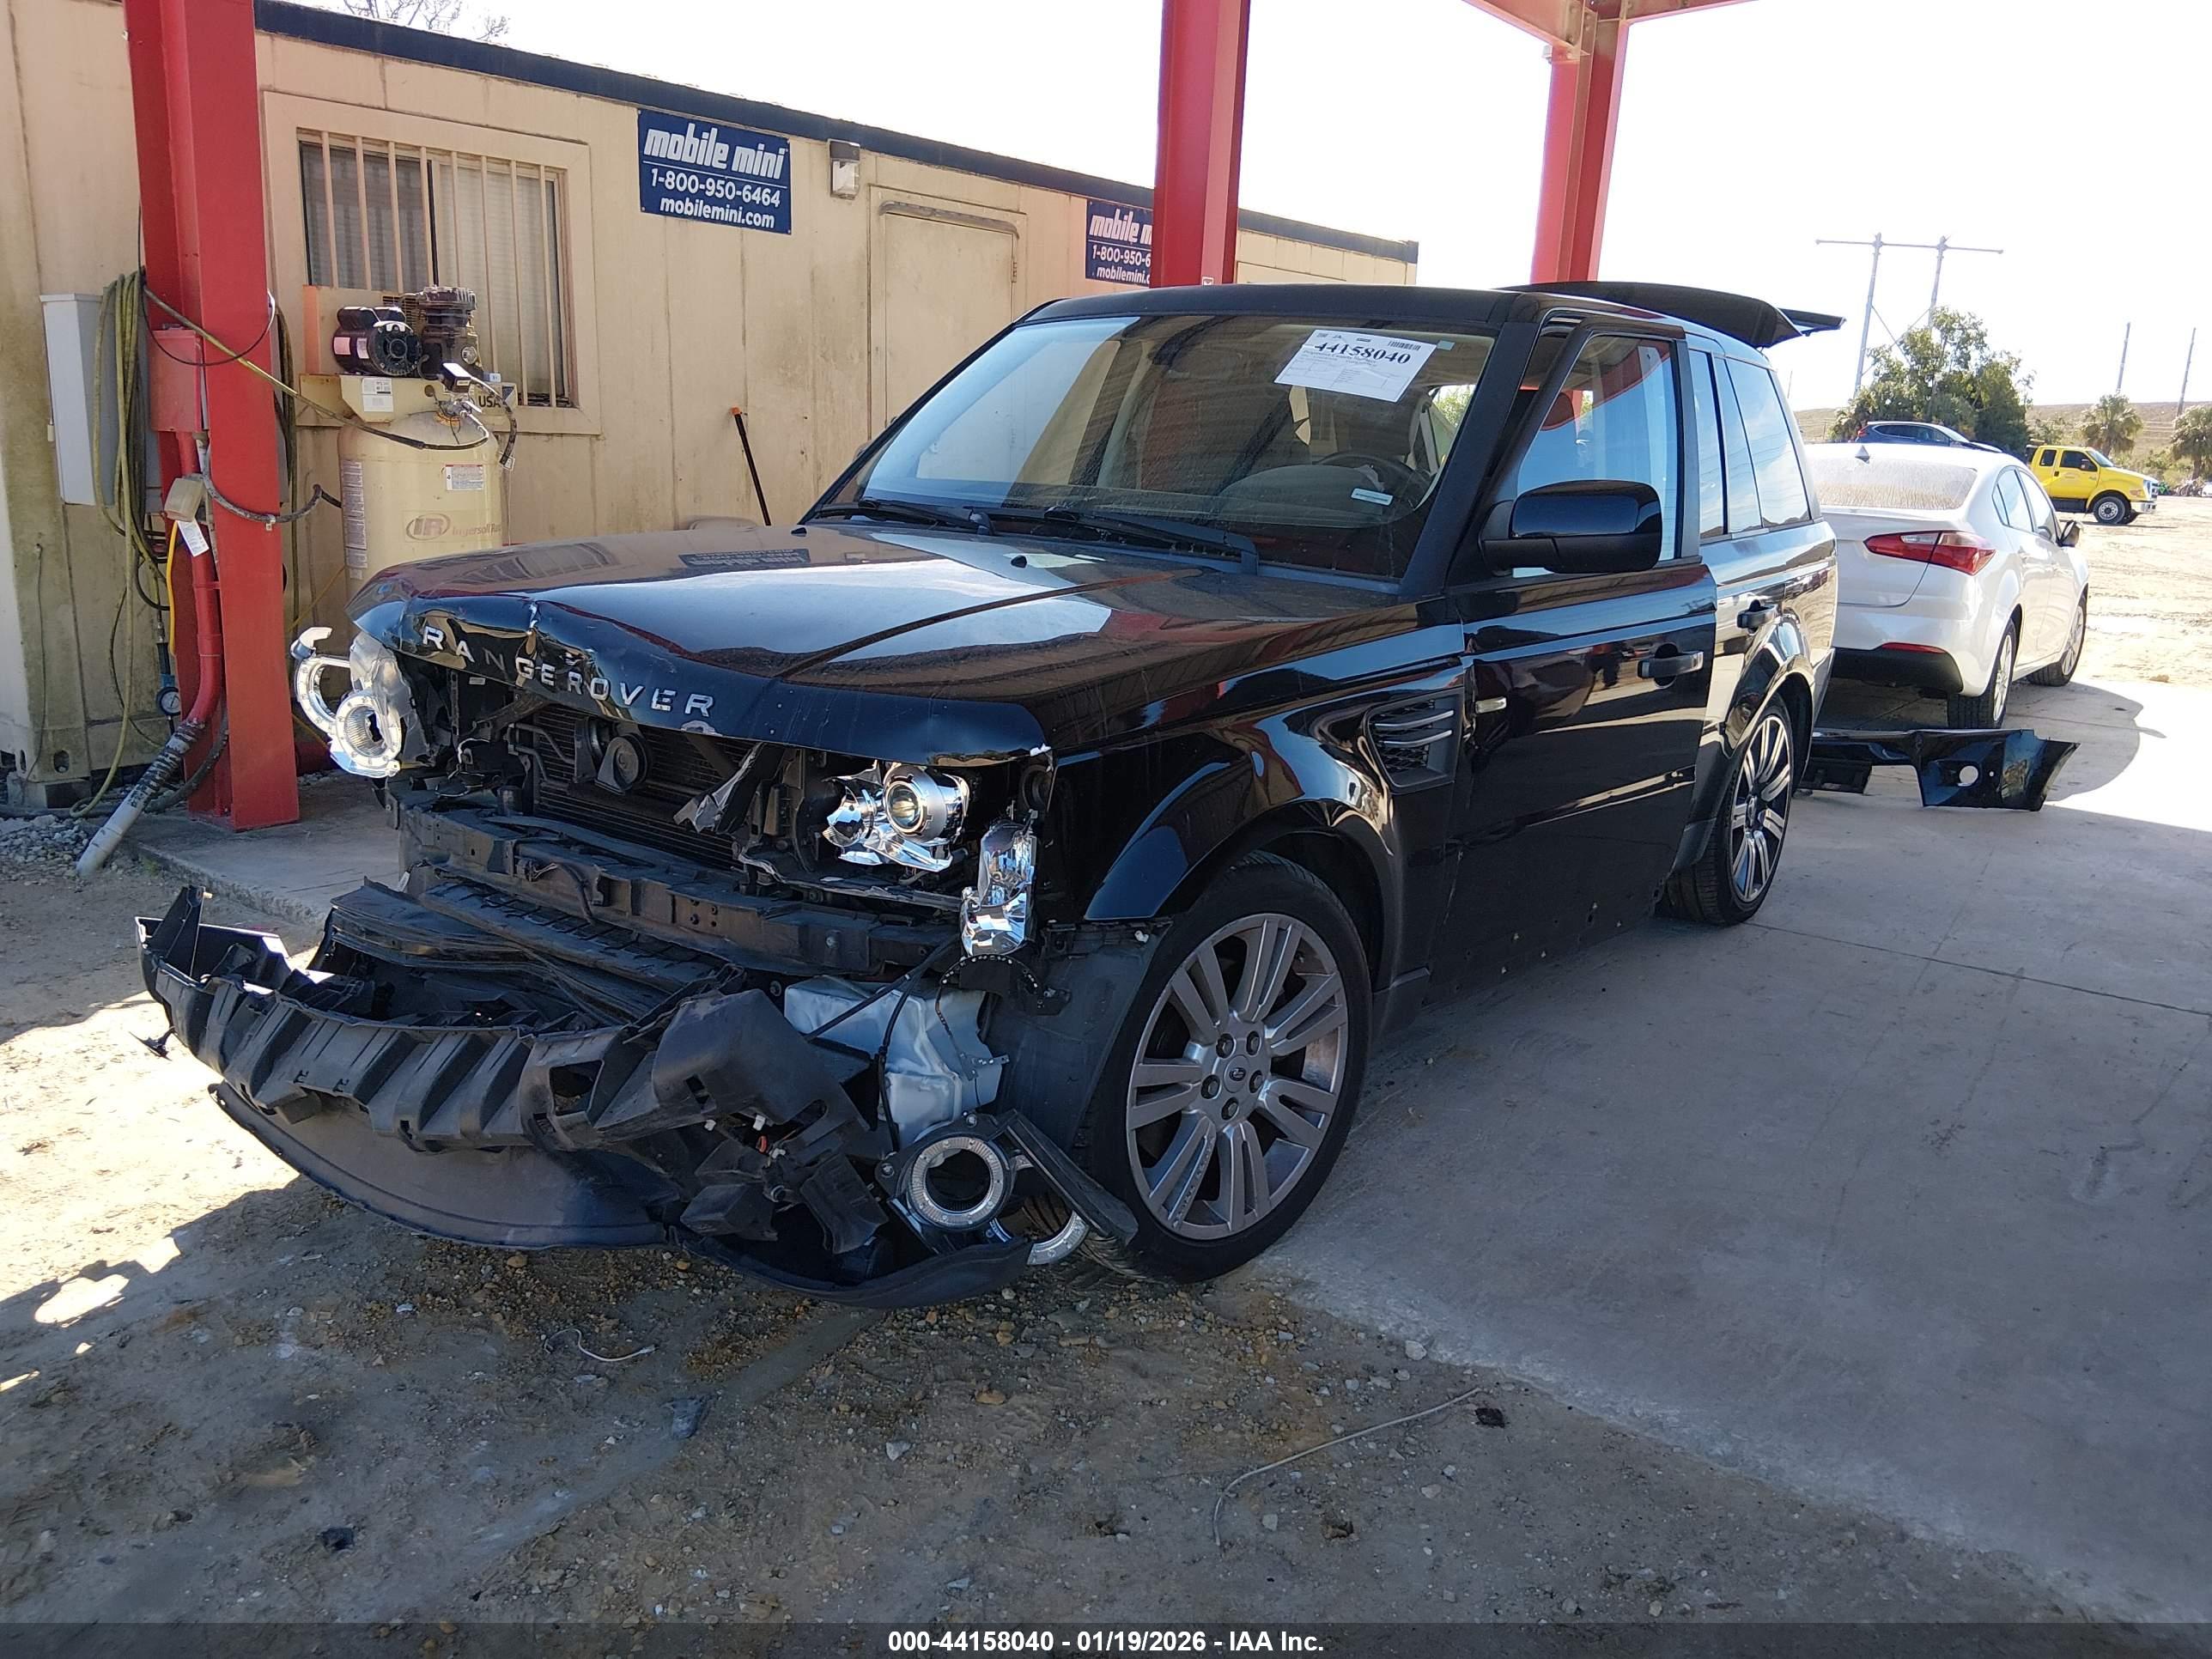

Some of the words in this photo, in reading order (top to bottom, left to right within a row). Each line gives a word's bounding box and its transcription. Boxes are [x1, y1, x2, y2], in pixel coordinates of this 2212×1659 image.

[643, 123, 729, 169] mobile
[731, 143, 786, 179] mini
[651, 168, 781, 208] 1-800-950-6464
[659, 197, 775, 228] mobilemini.com
[1089, 209, 1139, 243] mobile
[1092, 245, 1151, 267] 1-800-950-6
[1097, 266, 1150, 284] mobilemini.c
[1314, 342, 1411, 364] 44158040
[422, 626, 556, 687] RANGE
[567, 672, 714, 717] ROVER
